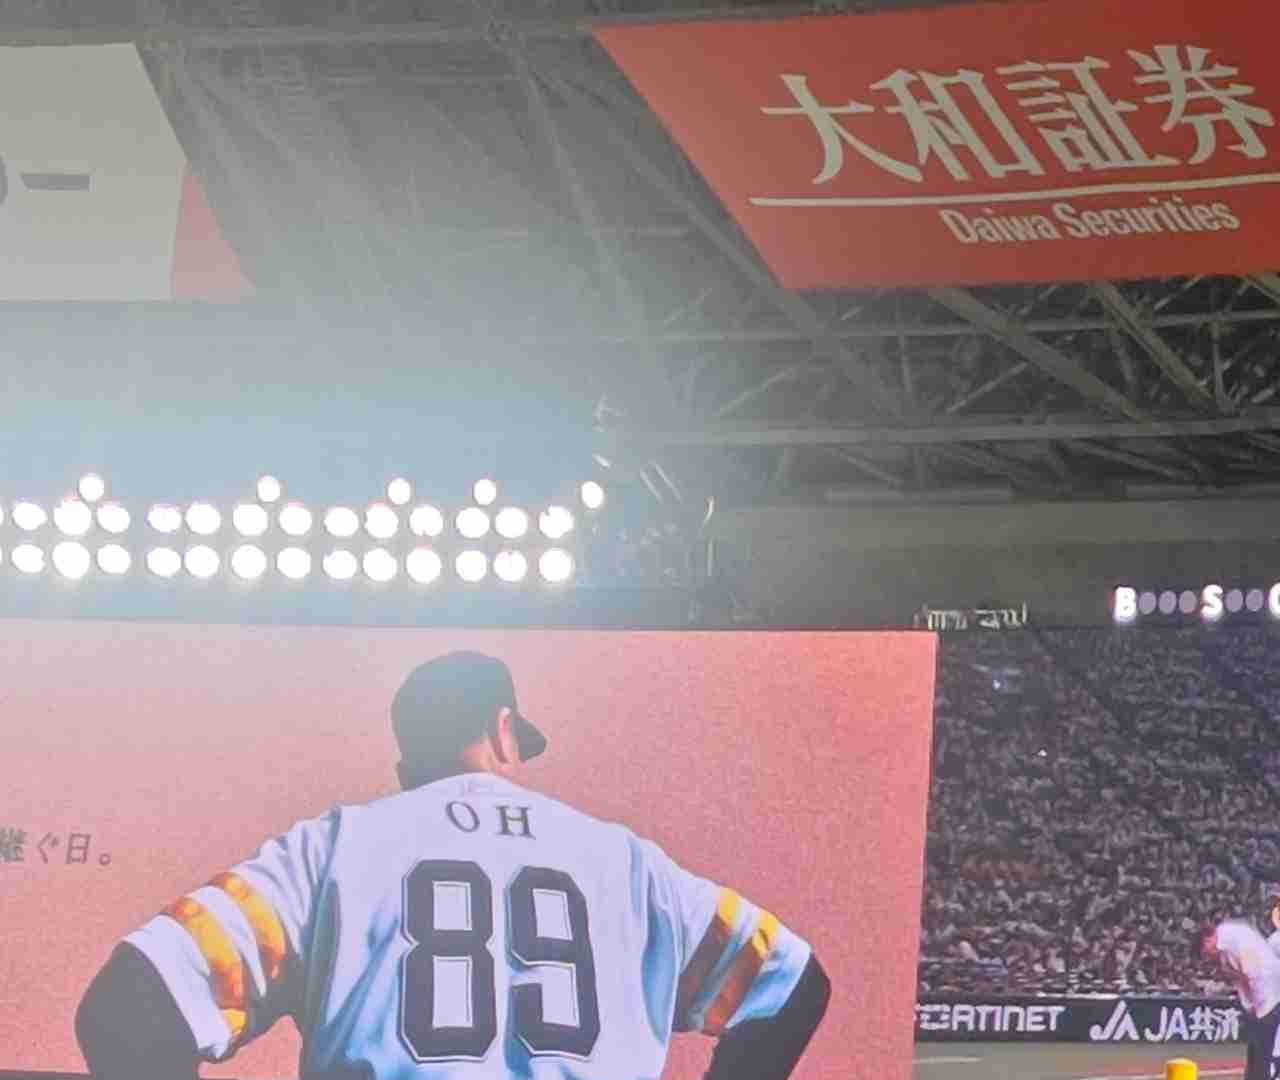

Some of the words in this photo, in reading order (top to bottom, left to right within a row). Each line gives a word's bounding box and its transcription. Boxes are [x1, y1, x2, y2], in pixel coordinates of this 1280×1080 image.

[759, 45, 1277, 185] 大和証券
[938, 207, 1062, 246] Daiwa
[1063, 198, 1242, 240] Securities
[444, 799, 537, 841] OH
[400, 858, 601, 1064] 89
